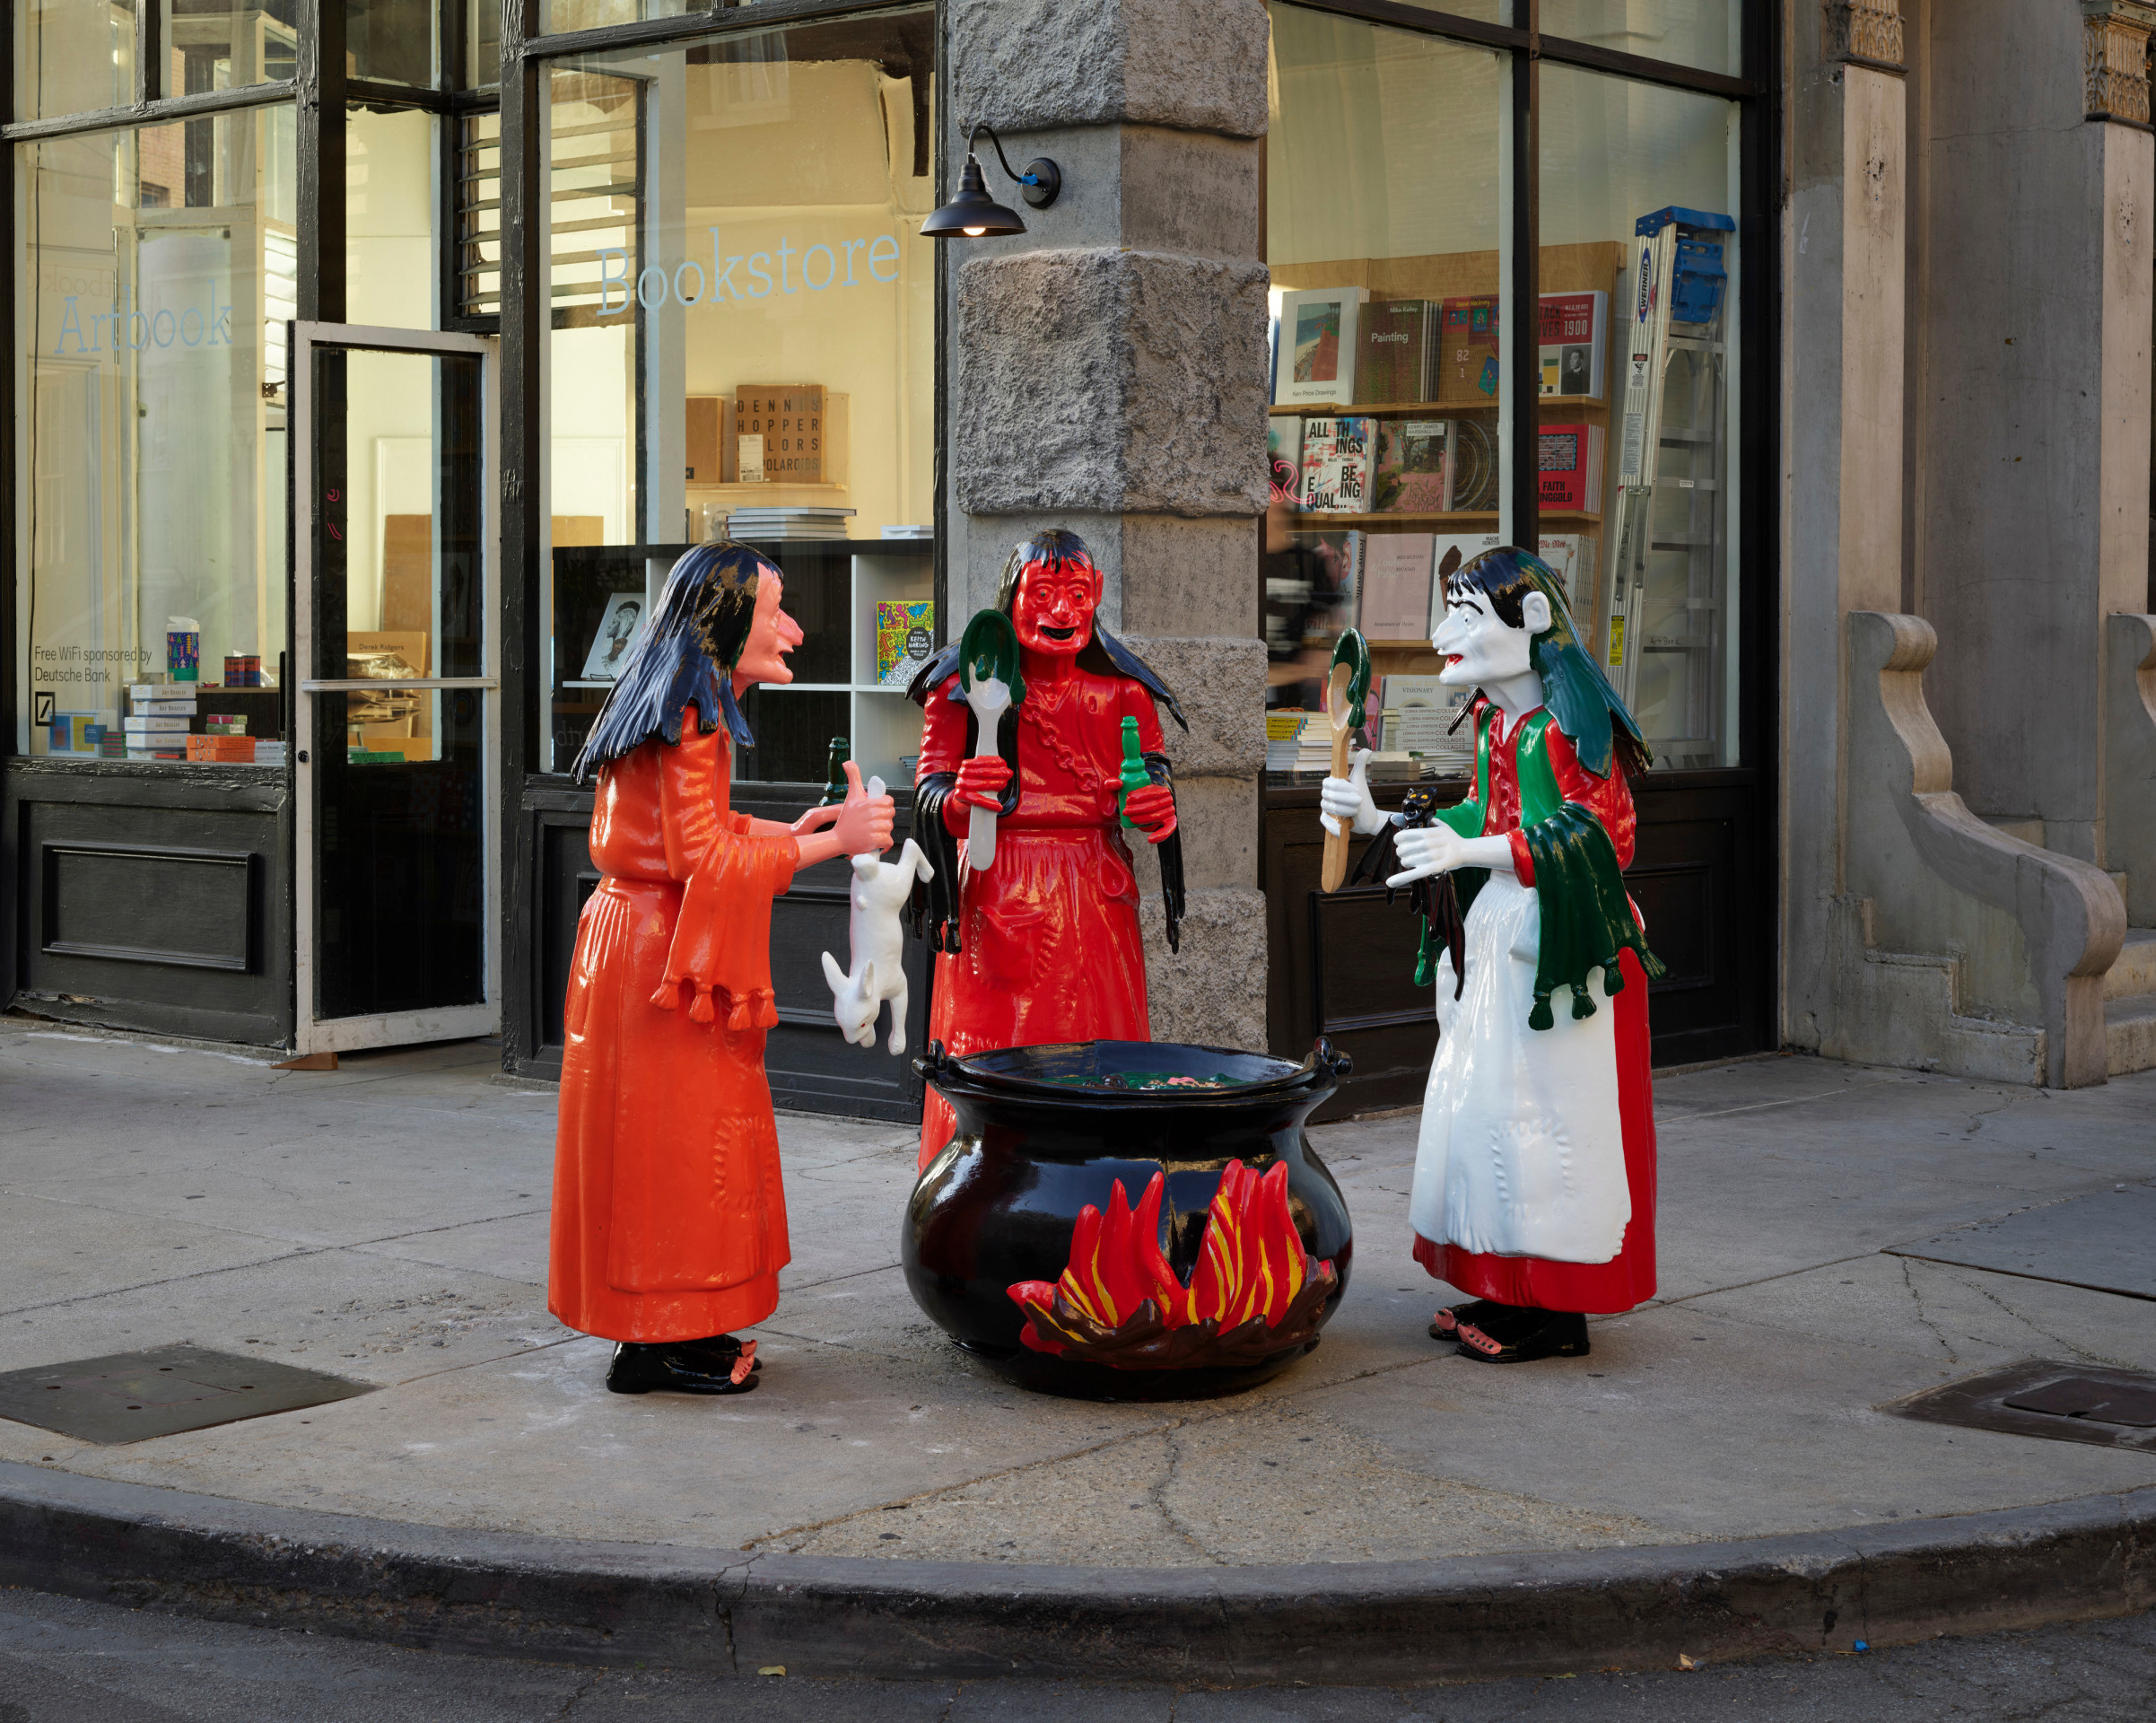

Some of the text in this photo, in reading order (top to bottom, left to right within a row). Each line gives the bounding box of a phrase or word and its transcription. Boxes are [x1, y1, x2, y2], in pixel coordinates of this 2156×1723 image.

[595, 226, 901, 317] Bookstore
[1640, 262, 1649, 309] WERNER
[54, 279, 234, 354] Artbook
[1539, 304, 1561, 320] LACK
[1539, 320, 1559, 338] IVES
[1564, 319, 1587, 337] 1900
[1371, 332, 1409, 345] Painting
[1456, 349, 1470, 362] 82
[1460, 367, 1465, 378] 1
[738, 398, 819, 413] DENNIS
[738, 418, 818, 433] HOPPER
[1308, 421, 1350, 438] ALL TH
[737, 437, 818, 451] LORS
[1335, 437, 1364, 454] INGS
[1340, 465, 1357, 482] BE
[1307, 476, 1315, 493] E
[1340, 482, 1361, 498] ING
[1542, 481, 1565, 492] FAITH
[1539, 492, 1573, 503] INGGOLD
[35, 645, 153, 666] Free WiFi sponsored by
[380, 643, 405, 652] Ridgers
[35, 667, 110, 682] Deutsche Bank
